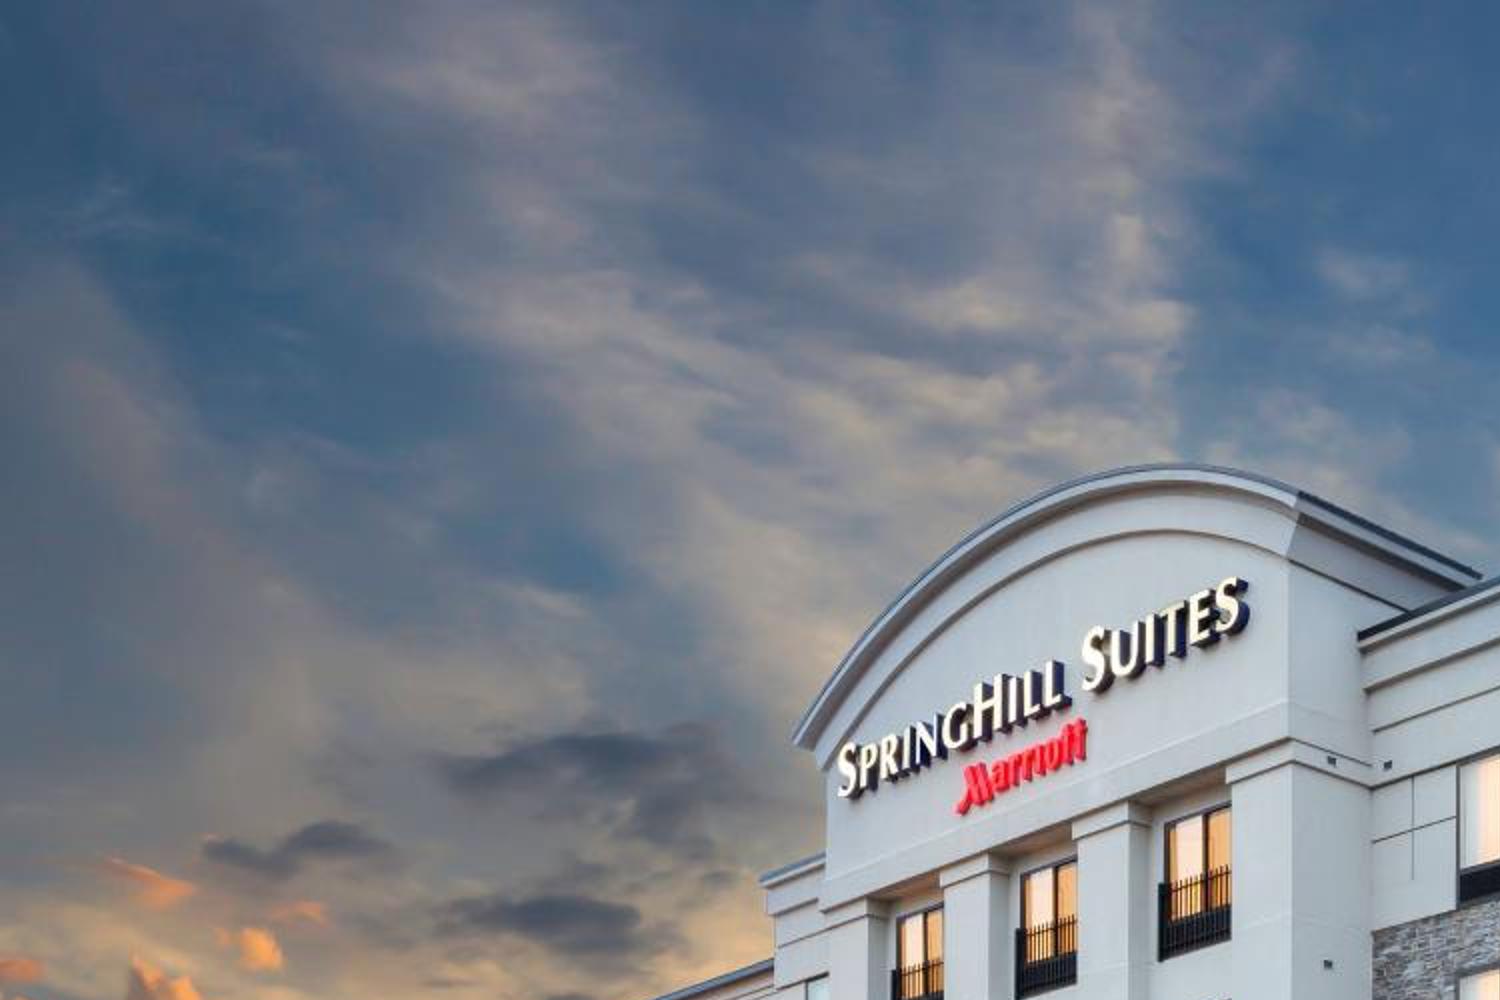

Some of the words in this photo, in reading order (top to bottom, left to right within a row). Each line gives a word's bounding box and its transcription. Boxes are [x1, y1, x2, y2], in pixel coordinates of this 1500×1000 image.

[838, 659, 1072, 798] SPRINGHILL
[1081, 577, 1250, 693] SUITES
[955, 717, 1088, 815] Marriott
